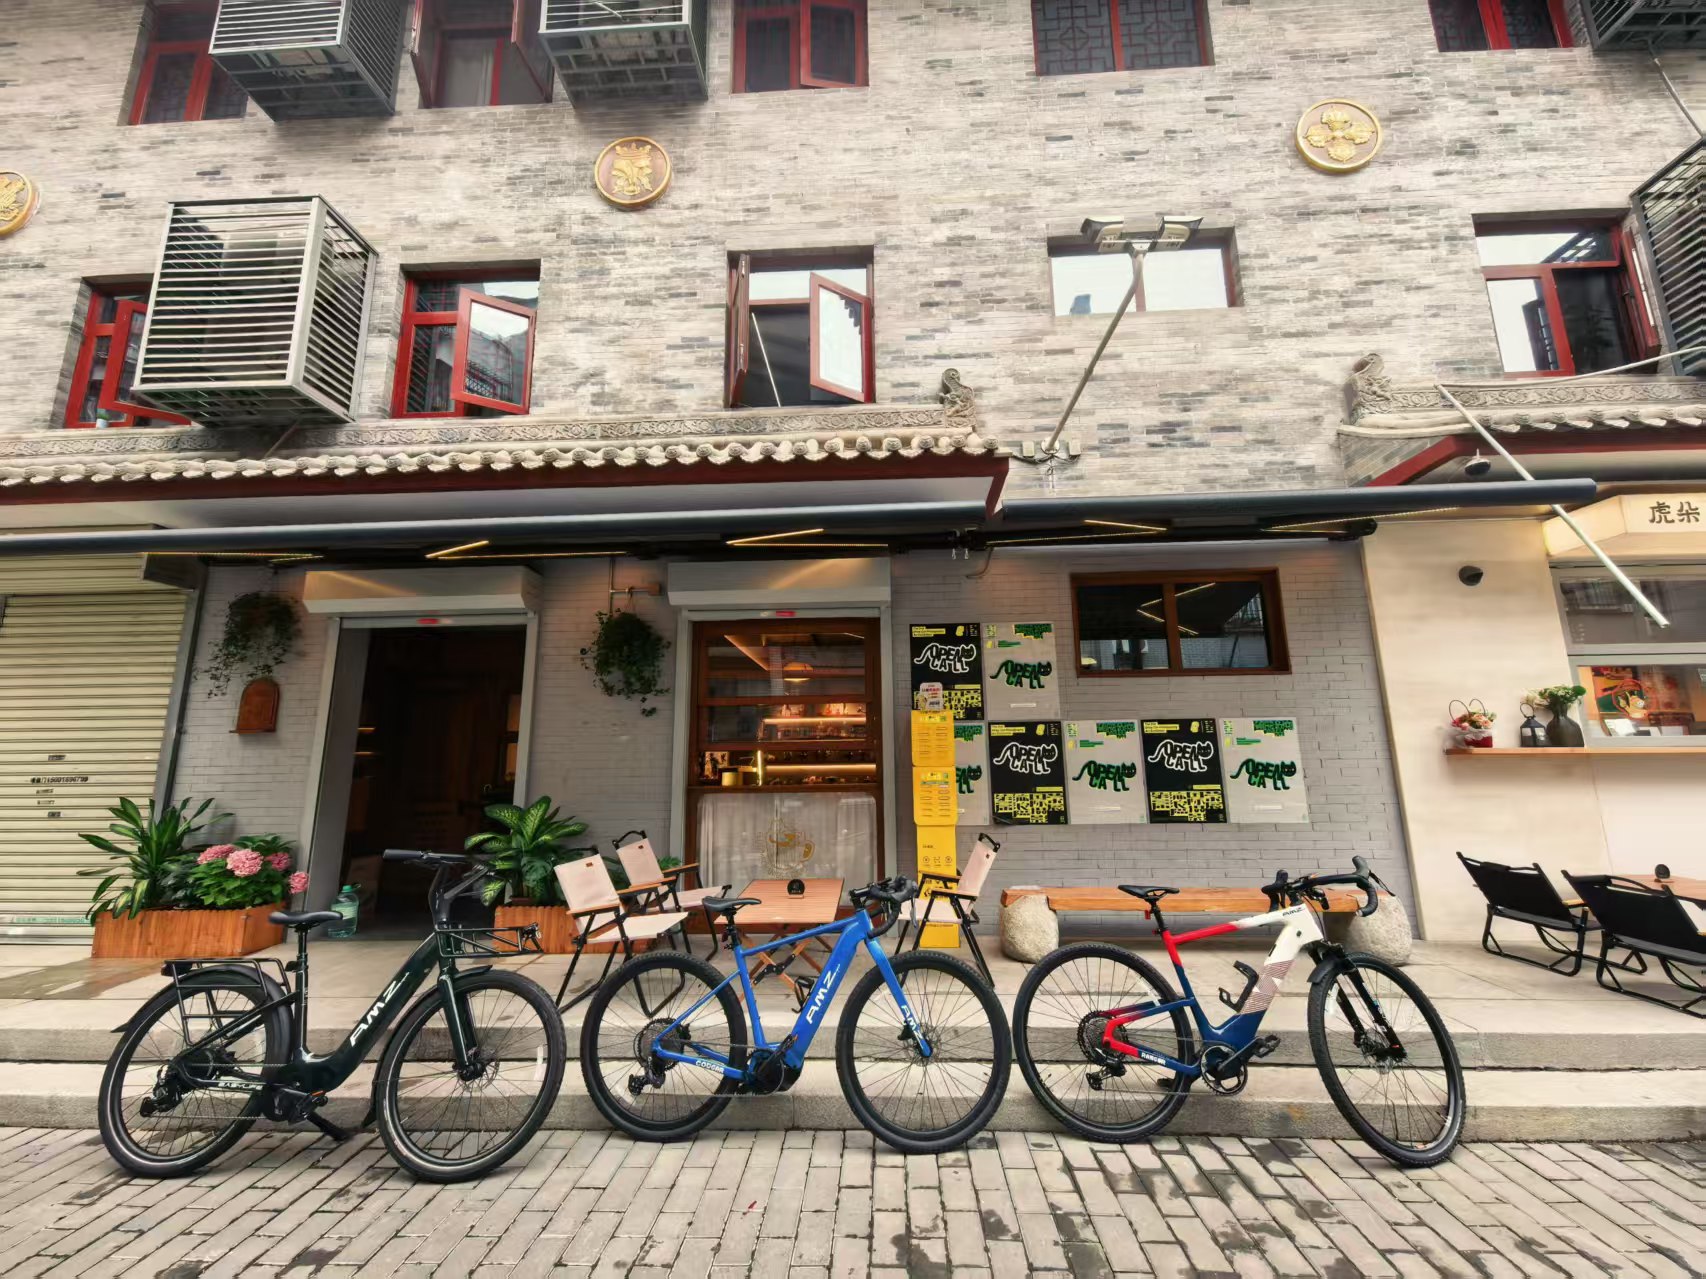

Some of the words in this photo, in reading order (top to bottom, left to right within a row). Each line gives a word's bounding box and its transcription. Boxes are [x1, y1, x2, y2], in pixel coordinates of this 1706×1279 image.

[1648, 500, 1700, 524] 虎朵
[349, 971, 410, 1048] AMZ
[806, 963, 841, 1025] AMZ
[901, 1004, 924, 1050] AMZ
